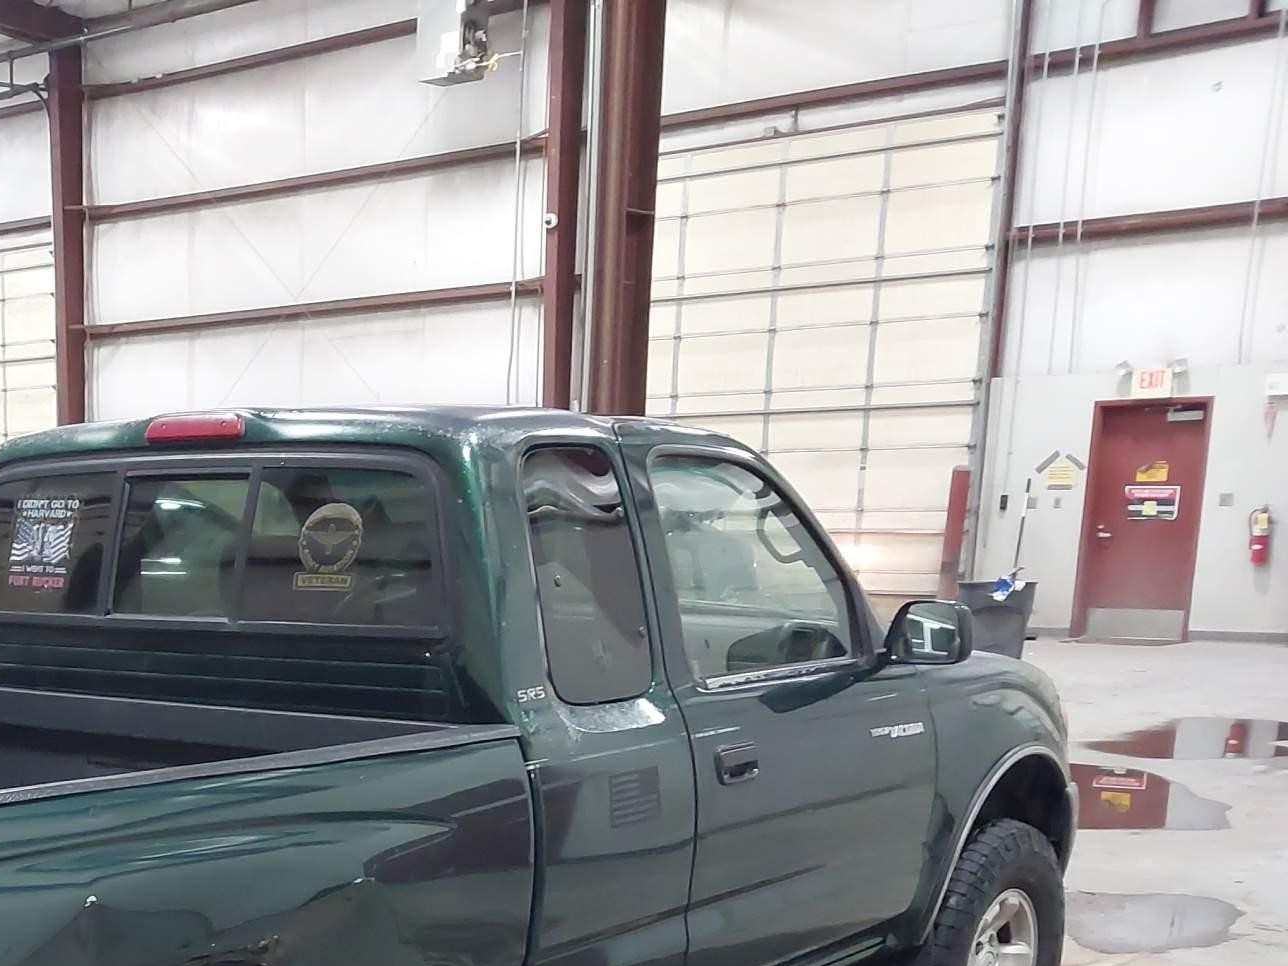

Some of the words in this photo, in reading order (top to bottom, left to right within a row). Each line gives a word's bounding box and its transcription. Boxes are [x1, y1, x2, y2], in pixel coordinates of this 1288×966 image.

[1139, 370, 1166, 389] EXIT
[51, 499, 65, 509] GO
[67, 499, 79, 509] TO
